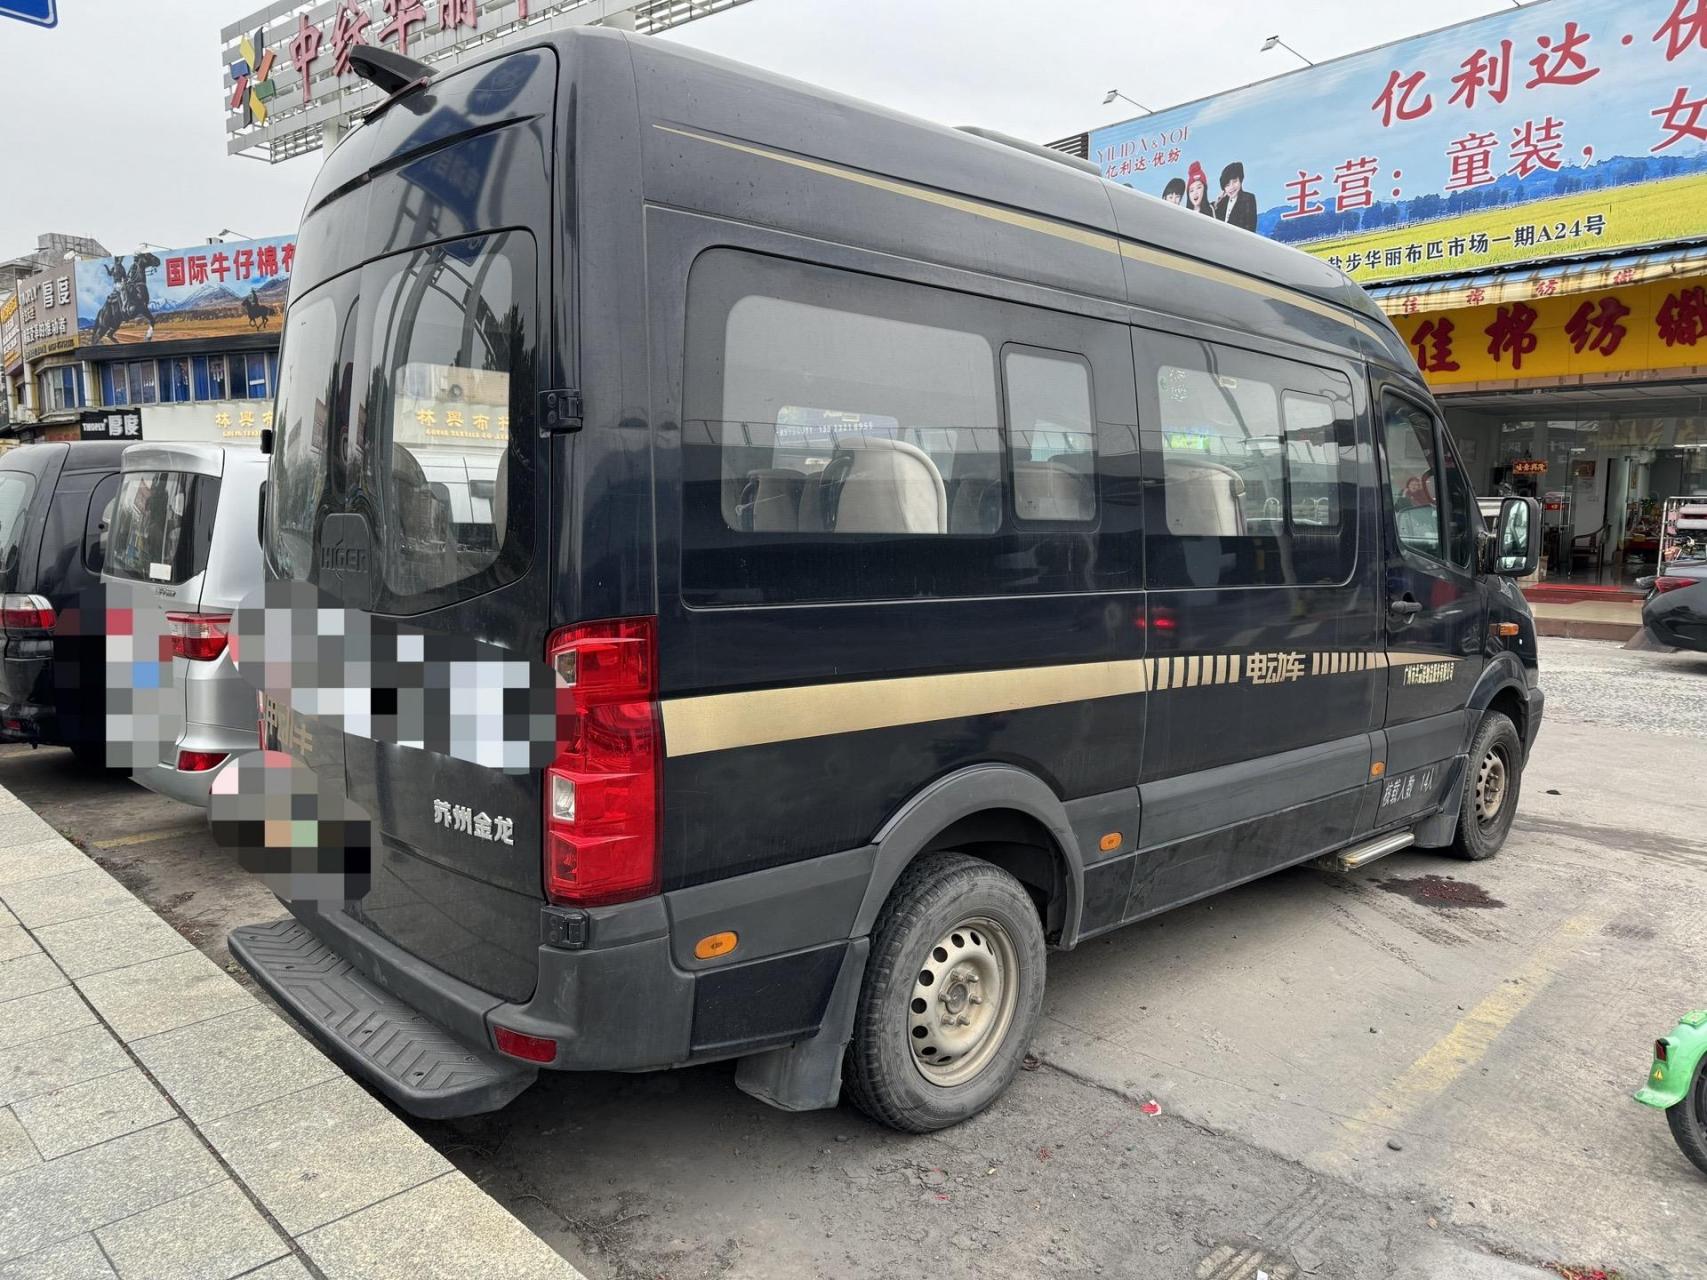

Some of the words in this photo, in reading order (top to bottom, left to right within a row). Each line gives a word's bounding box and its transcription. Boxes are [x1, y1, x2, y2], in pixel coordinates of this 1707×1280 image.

[108, 414, 140, 436] 厚度
[1246, 652, 1306, 684] 电动车
[433, 799, 515, 845] 苏州金龙
